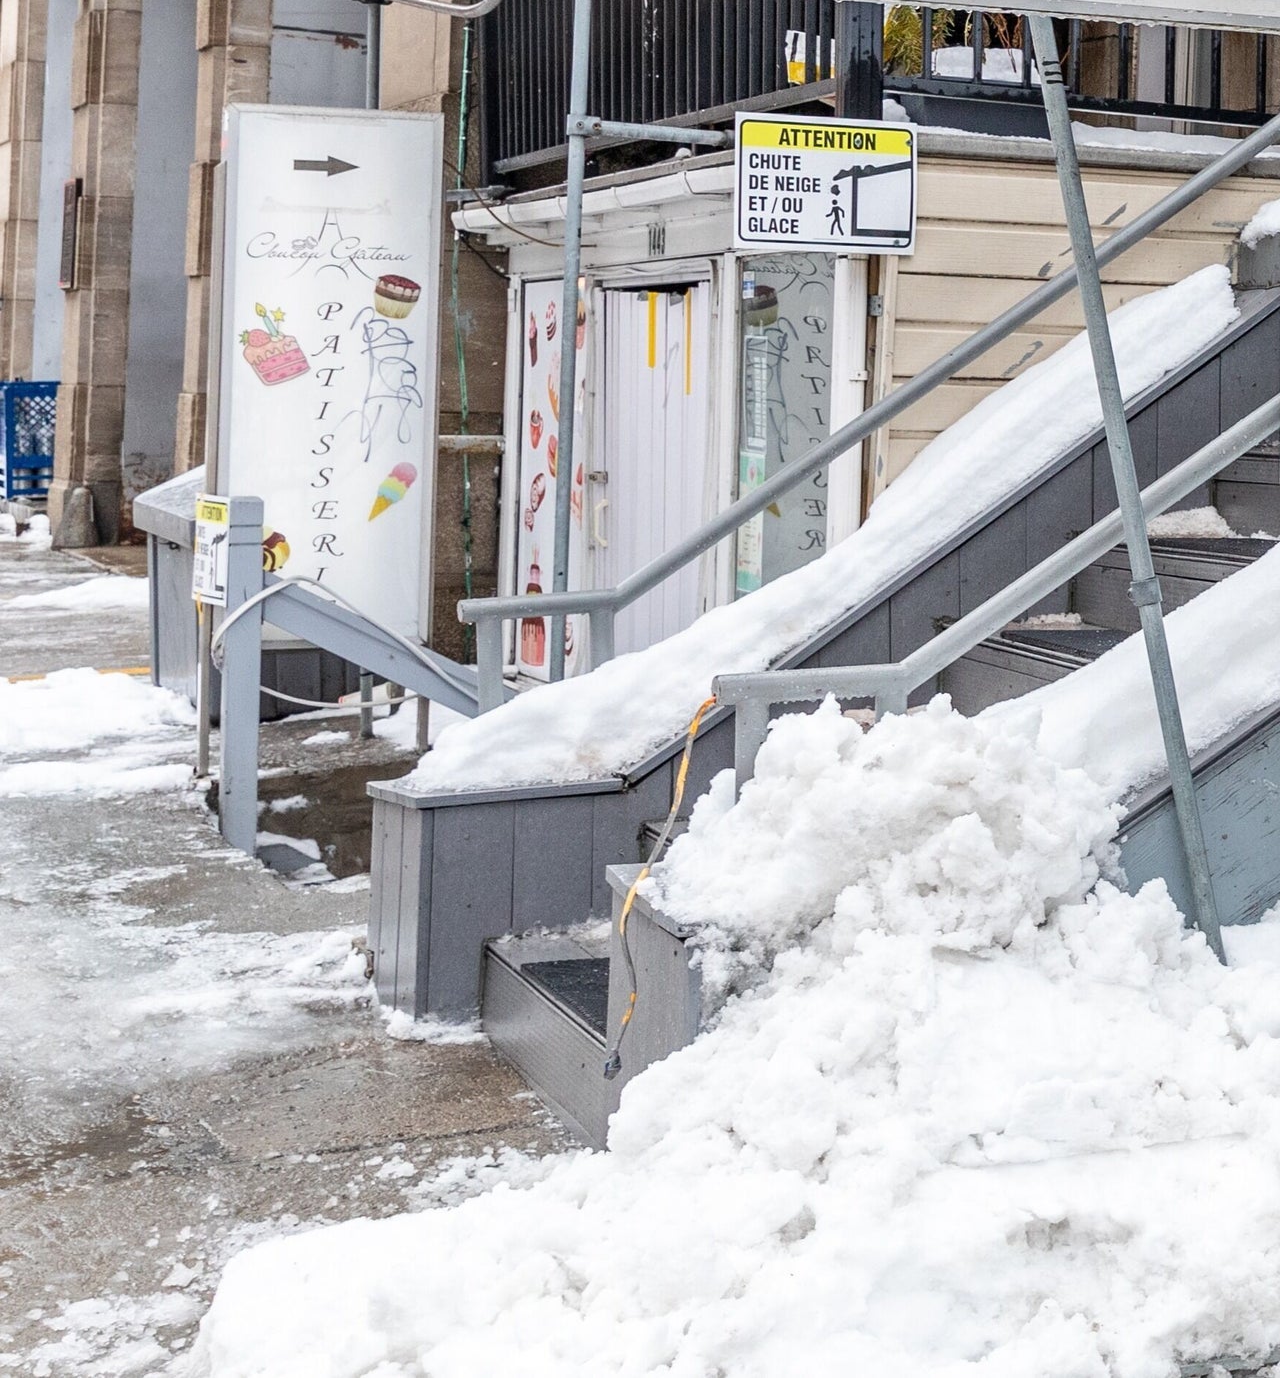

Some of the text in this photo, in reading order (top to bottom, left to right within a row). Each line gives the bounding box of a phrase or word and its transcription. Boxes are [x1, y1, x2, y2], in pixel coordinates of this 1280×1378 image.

[778, 128, 877, 151] ATTENTION
[749, 152, 802, 172] CHUTE
[749, 174, 822, 194] DE NEIGE
[749, 196, 768, 212] ET
[782, 197, 803, 214] OU
[748, 217, 800, 235] GLACE
